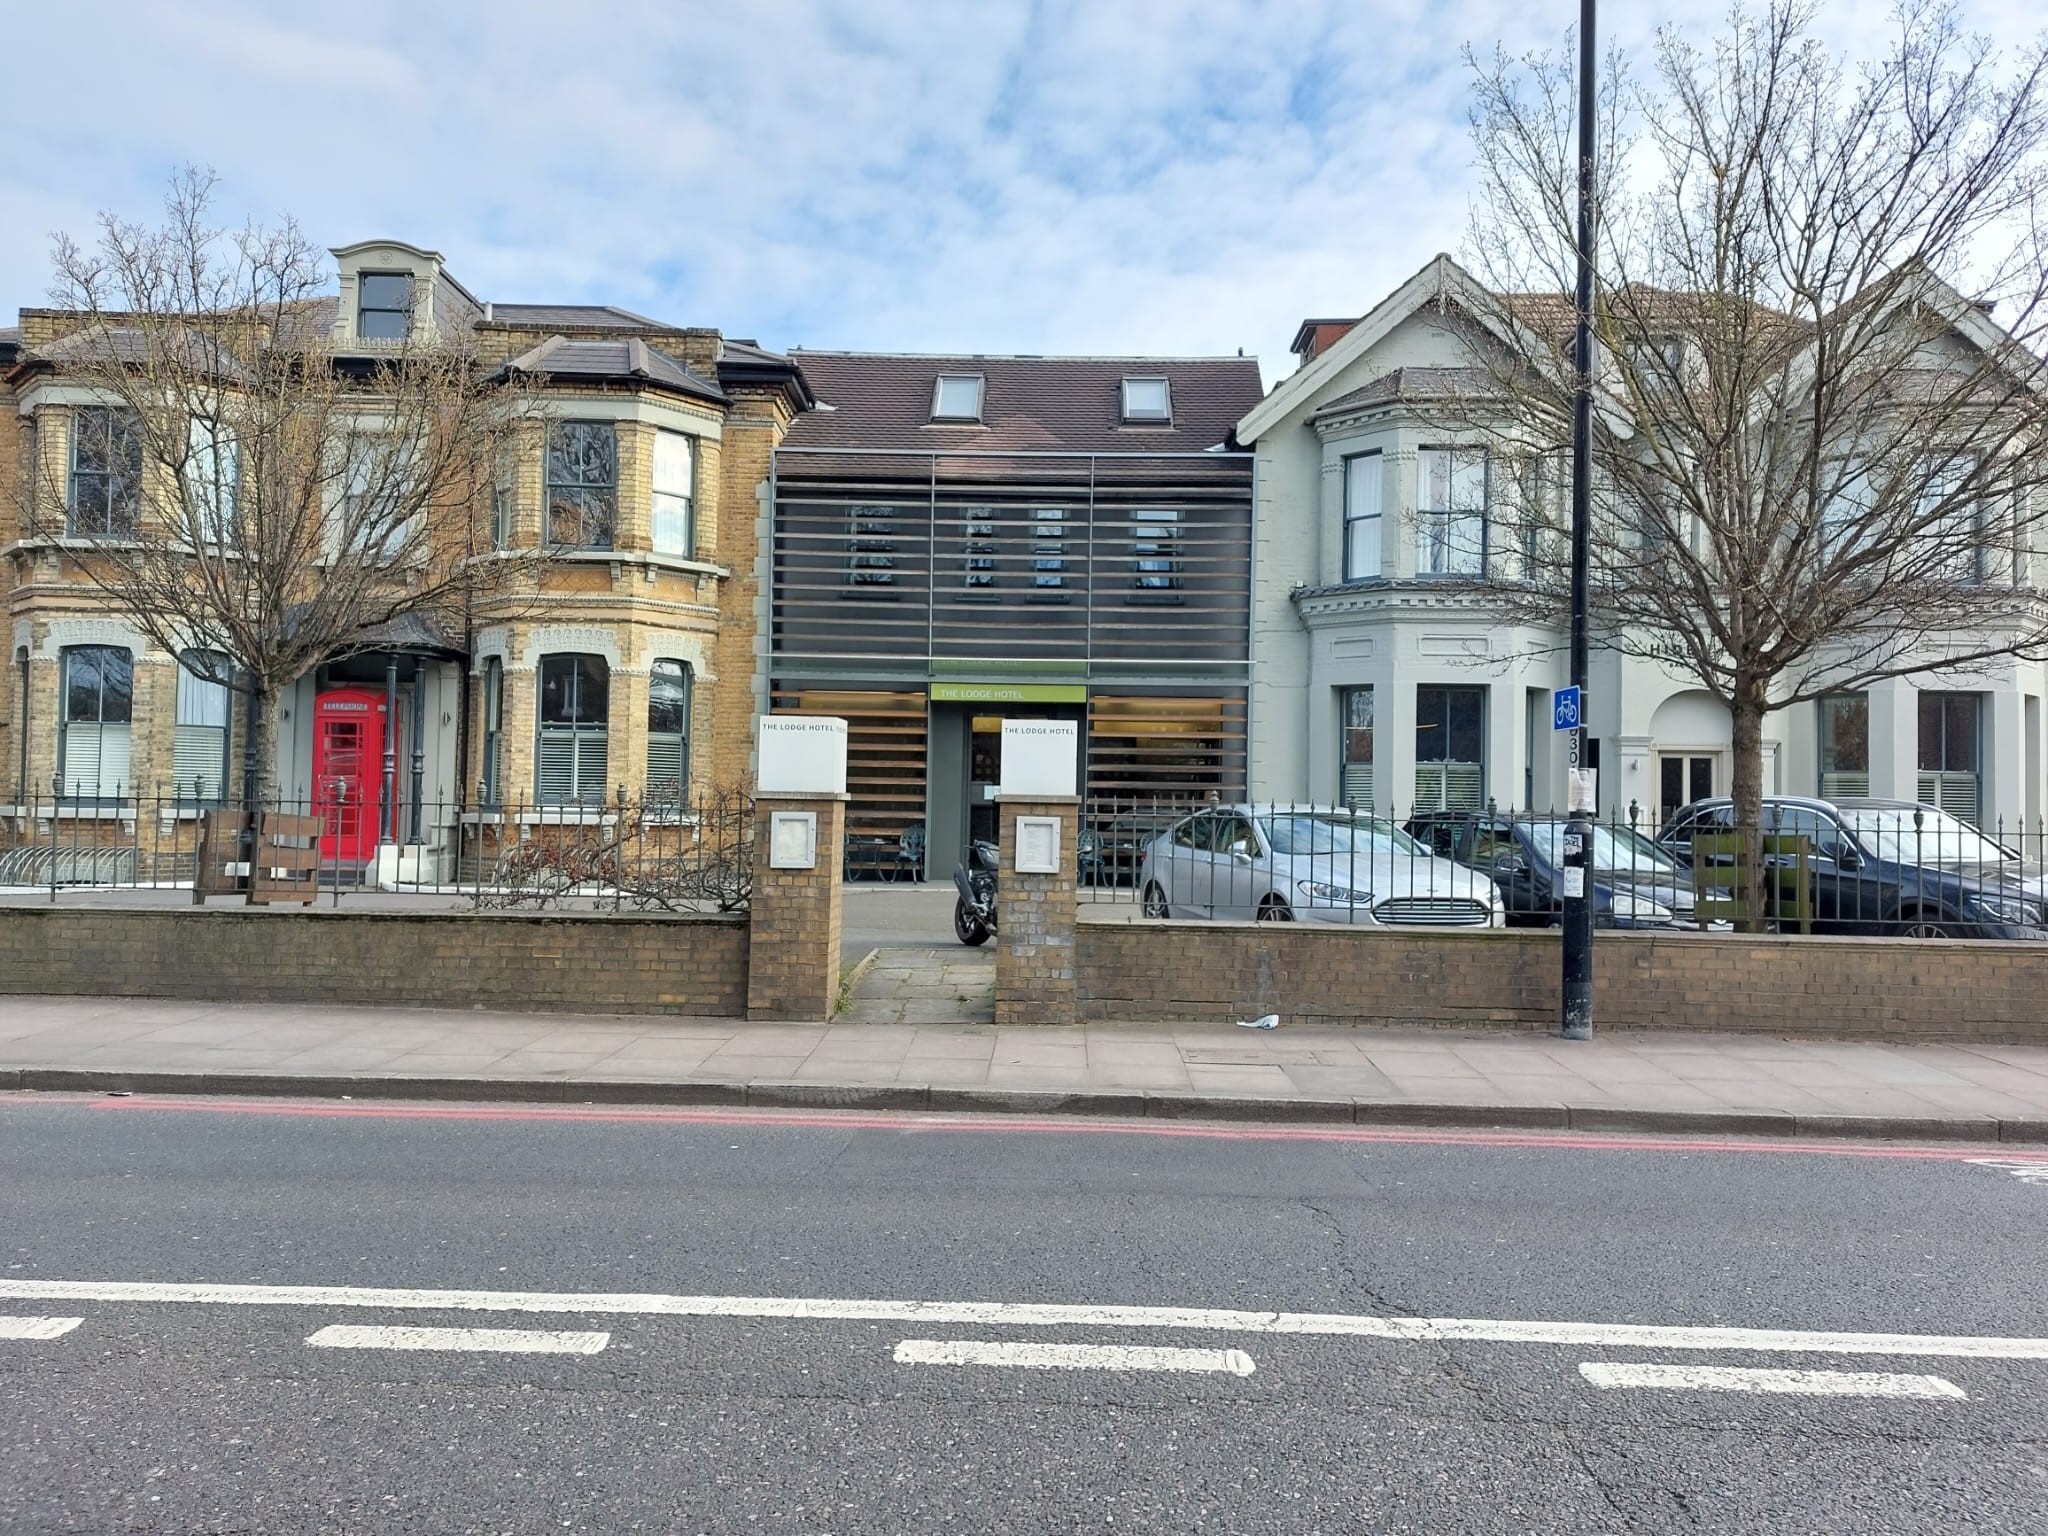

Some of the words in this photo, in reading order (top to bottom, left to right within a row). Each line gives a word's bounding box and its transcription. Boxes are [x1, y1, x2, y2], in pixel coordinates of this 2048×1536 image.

[941, 689, 957, 697] THE
[961, 689, 991, 698] LODGE
[994, 690, 1024, 699] HOTEL
[780, 723, 806, 731] LODGE
[808, 724, 834, 732] HOTEL
[1021, 727, 1046, 735] LODGE
